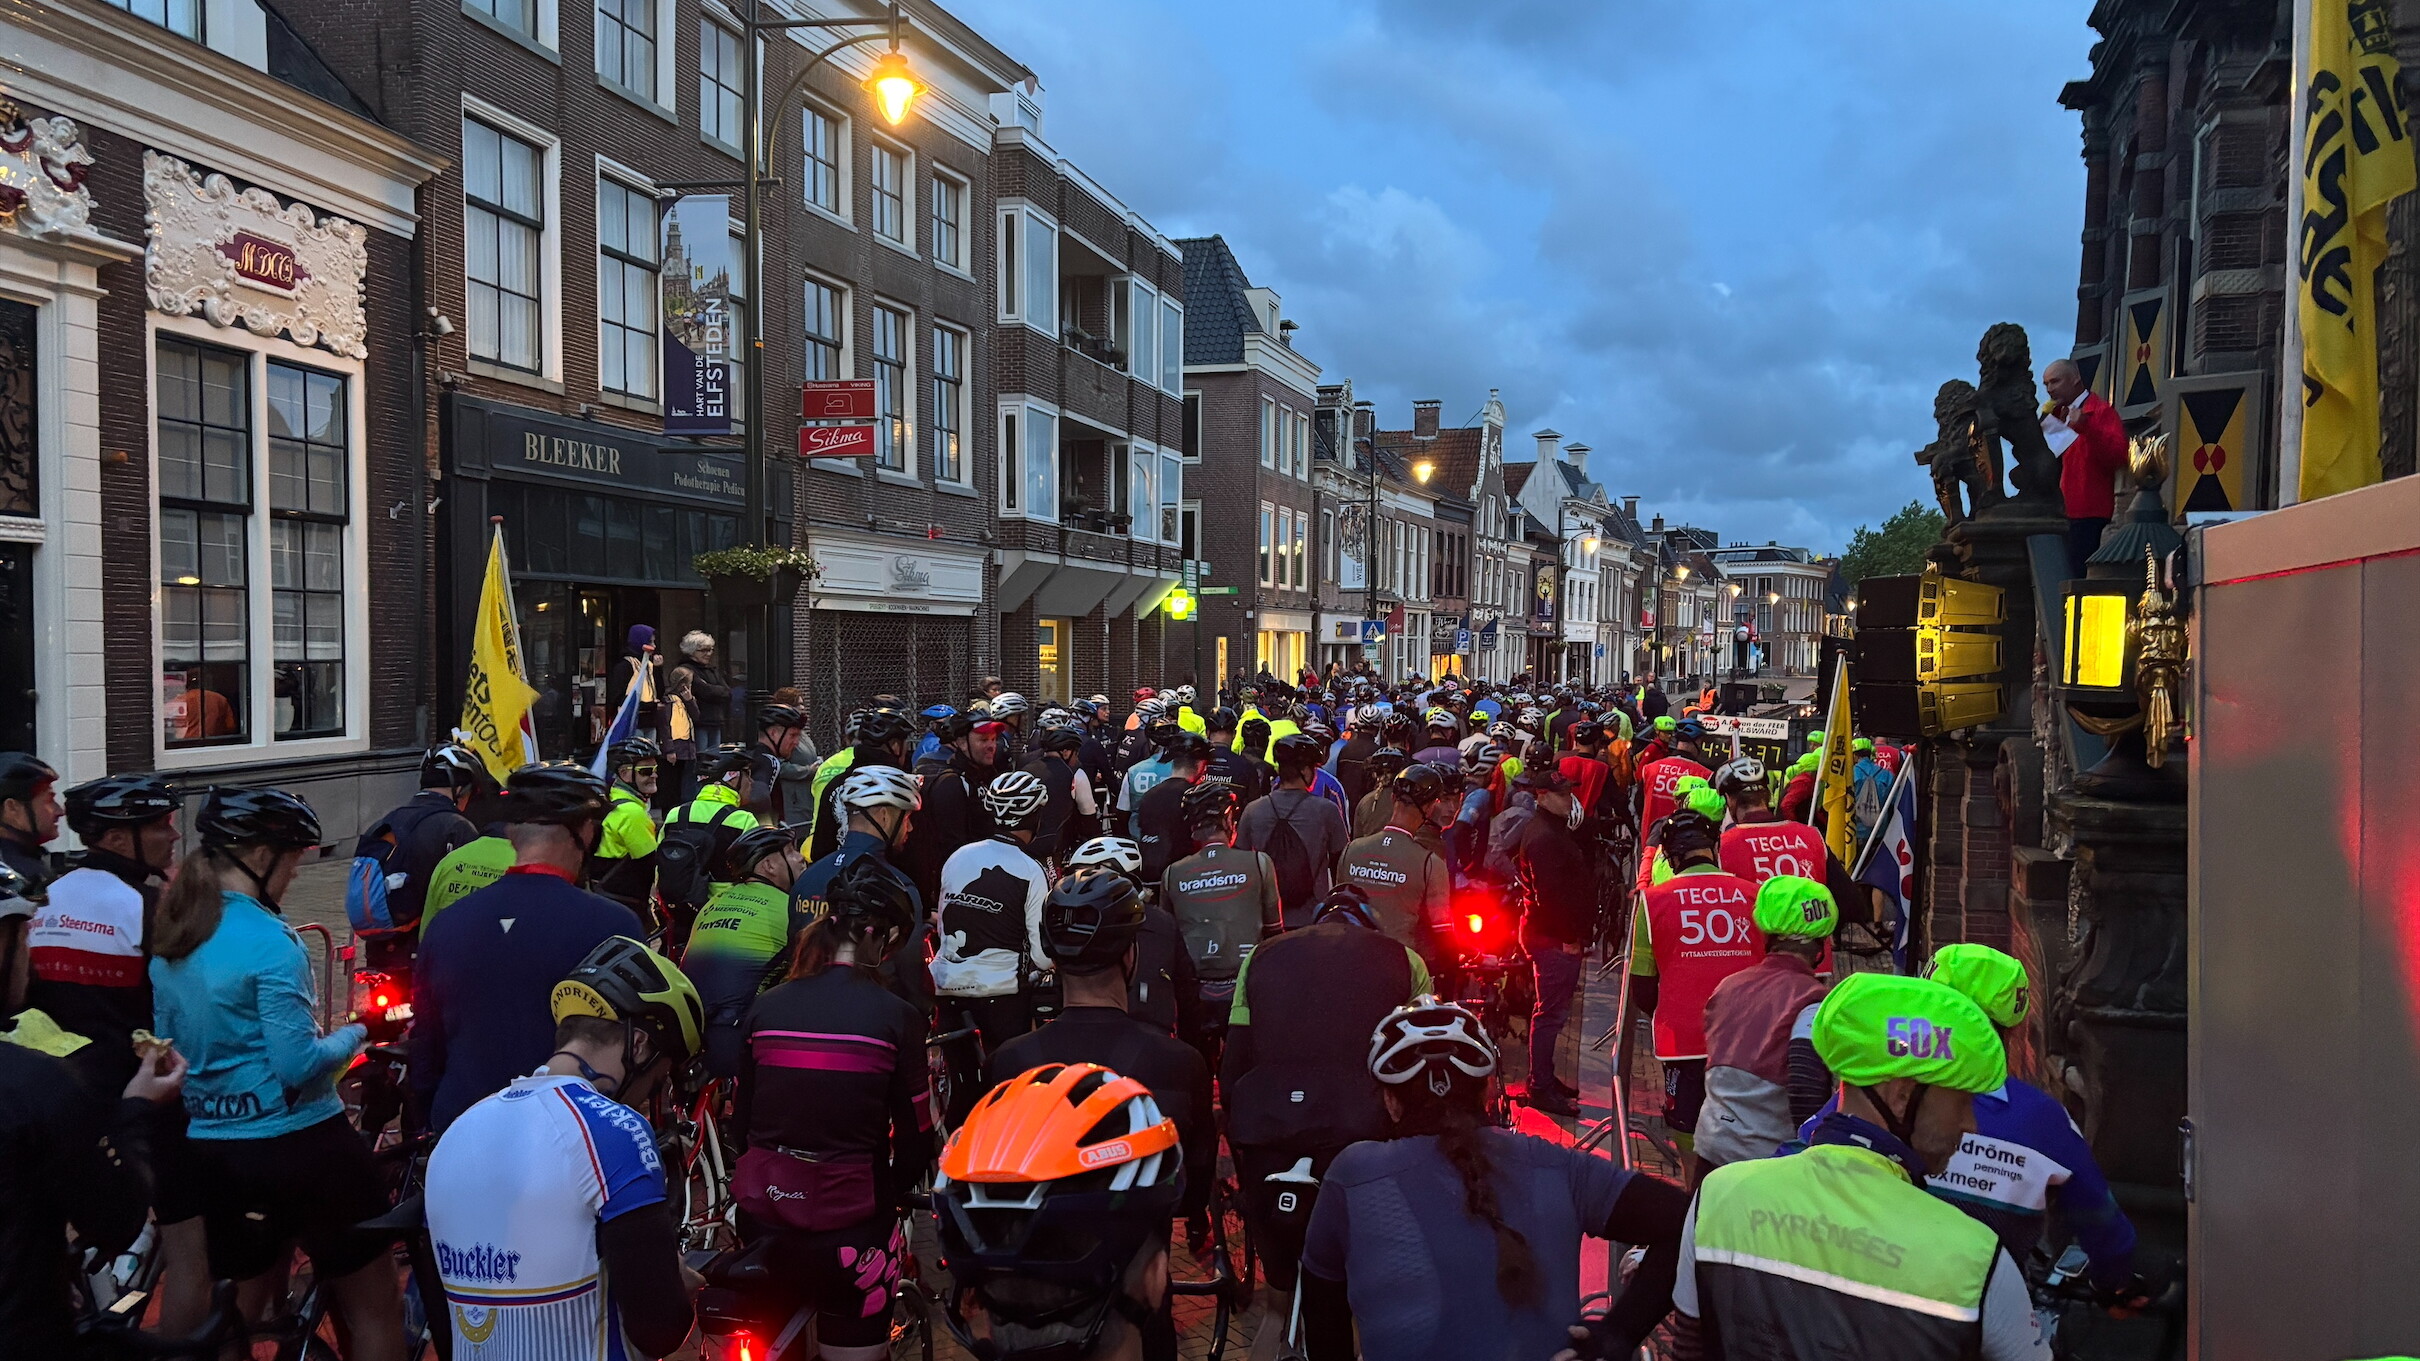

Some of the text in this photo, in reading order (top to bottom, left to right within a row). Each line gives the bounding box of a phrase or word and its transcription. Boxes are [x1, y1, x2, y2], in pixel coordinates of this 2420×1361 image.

[706, 298, 724, 418] ELFSTEDEN
[695, 355, 704, 417] HART VAN DE
[808, 427, 868, 450] Sikma
[524, 432, 622, 475] BLEEKER
[697, 460, 730, 479] Schoenen
[673, 472, 745, 497] Podotherapie Pedicu
[1728, 726, 1778, 736] BLSWARD
[1200, 774, 1233, 784] olsward
[1659, 763, 1690, 776] TECLA
[1745, 834, 1809, 853] TECLA
[1179, 873, 1247, 892] brandsma
[1349, 863, 1407, 884] brandsma
[943, 892, 1004, 912] MARIN
[1674, 887, 1747, 905] TECLA
[59, 914, 115, 936] Steensma
[1887, 1016, 1954, 1061] 50X
[576, 1094, 663, 1173] Buckler
[1087, 1144, 1127, 1163] ABUS
[1973, 1162, 2022, 1183] pennings
[766, 1184, 808, 1201] Rogelli
[436, 1239, 522, 1284] Buckler
